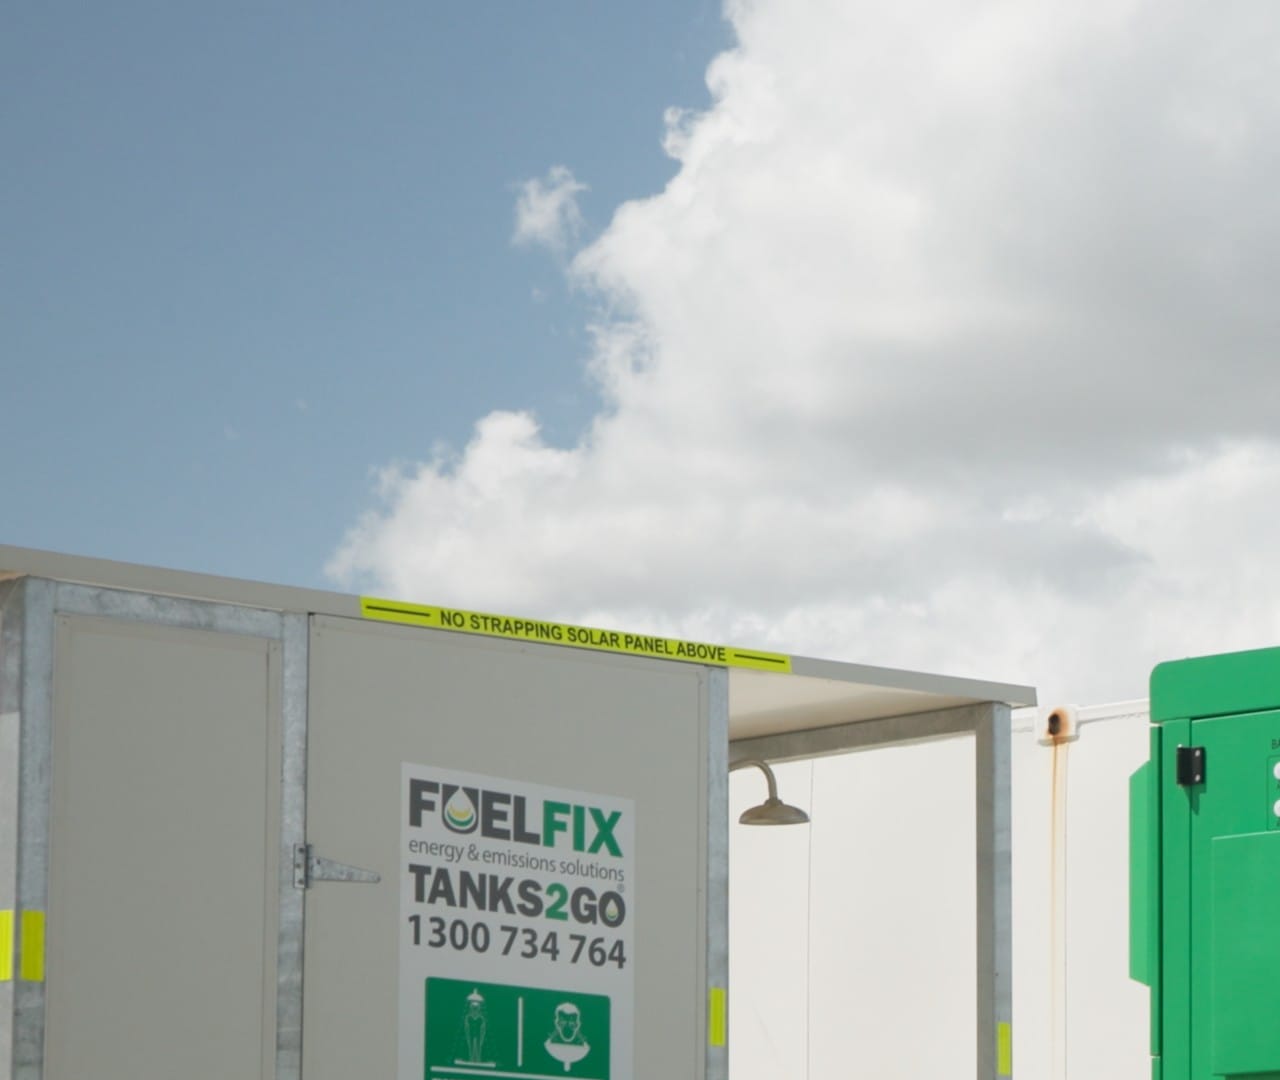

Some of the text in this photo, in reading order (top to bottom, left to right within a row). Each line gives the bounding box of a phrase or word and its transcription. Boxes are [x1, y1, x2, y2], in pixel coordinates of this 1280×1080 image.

[440, 609, 726, 662] NO STRAPPING SOLAR PANEL ABOVE
[409, 778, 624, 858] FUELFIX
[409, 840, 625, 882] energy & emissions solutions
[408, 863, 626, 928] TANKS2GO
[408, 914, 626, 969] 1300 734 764
